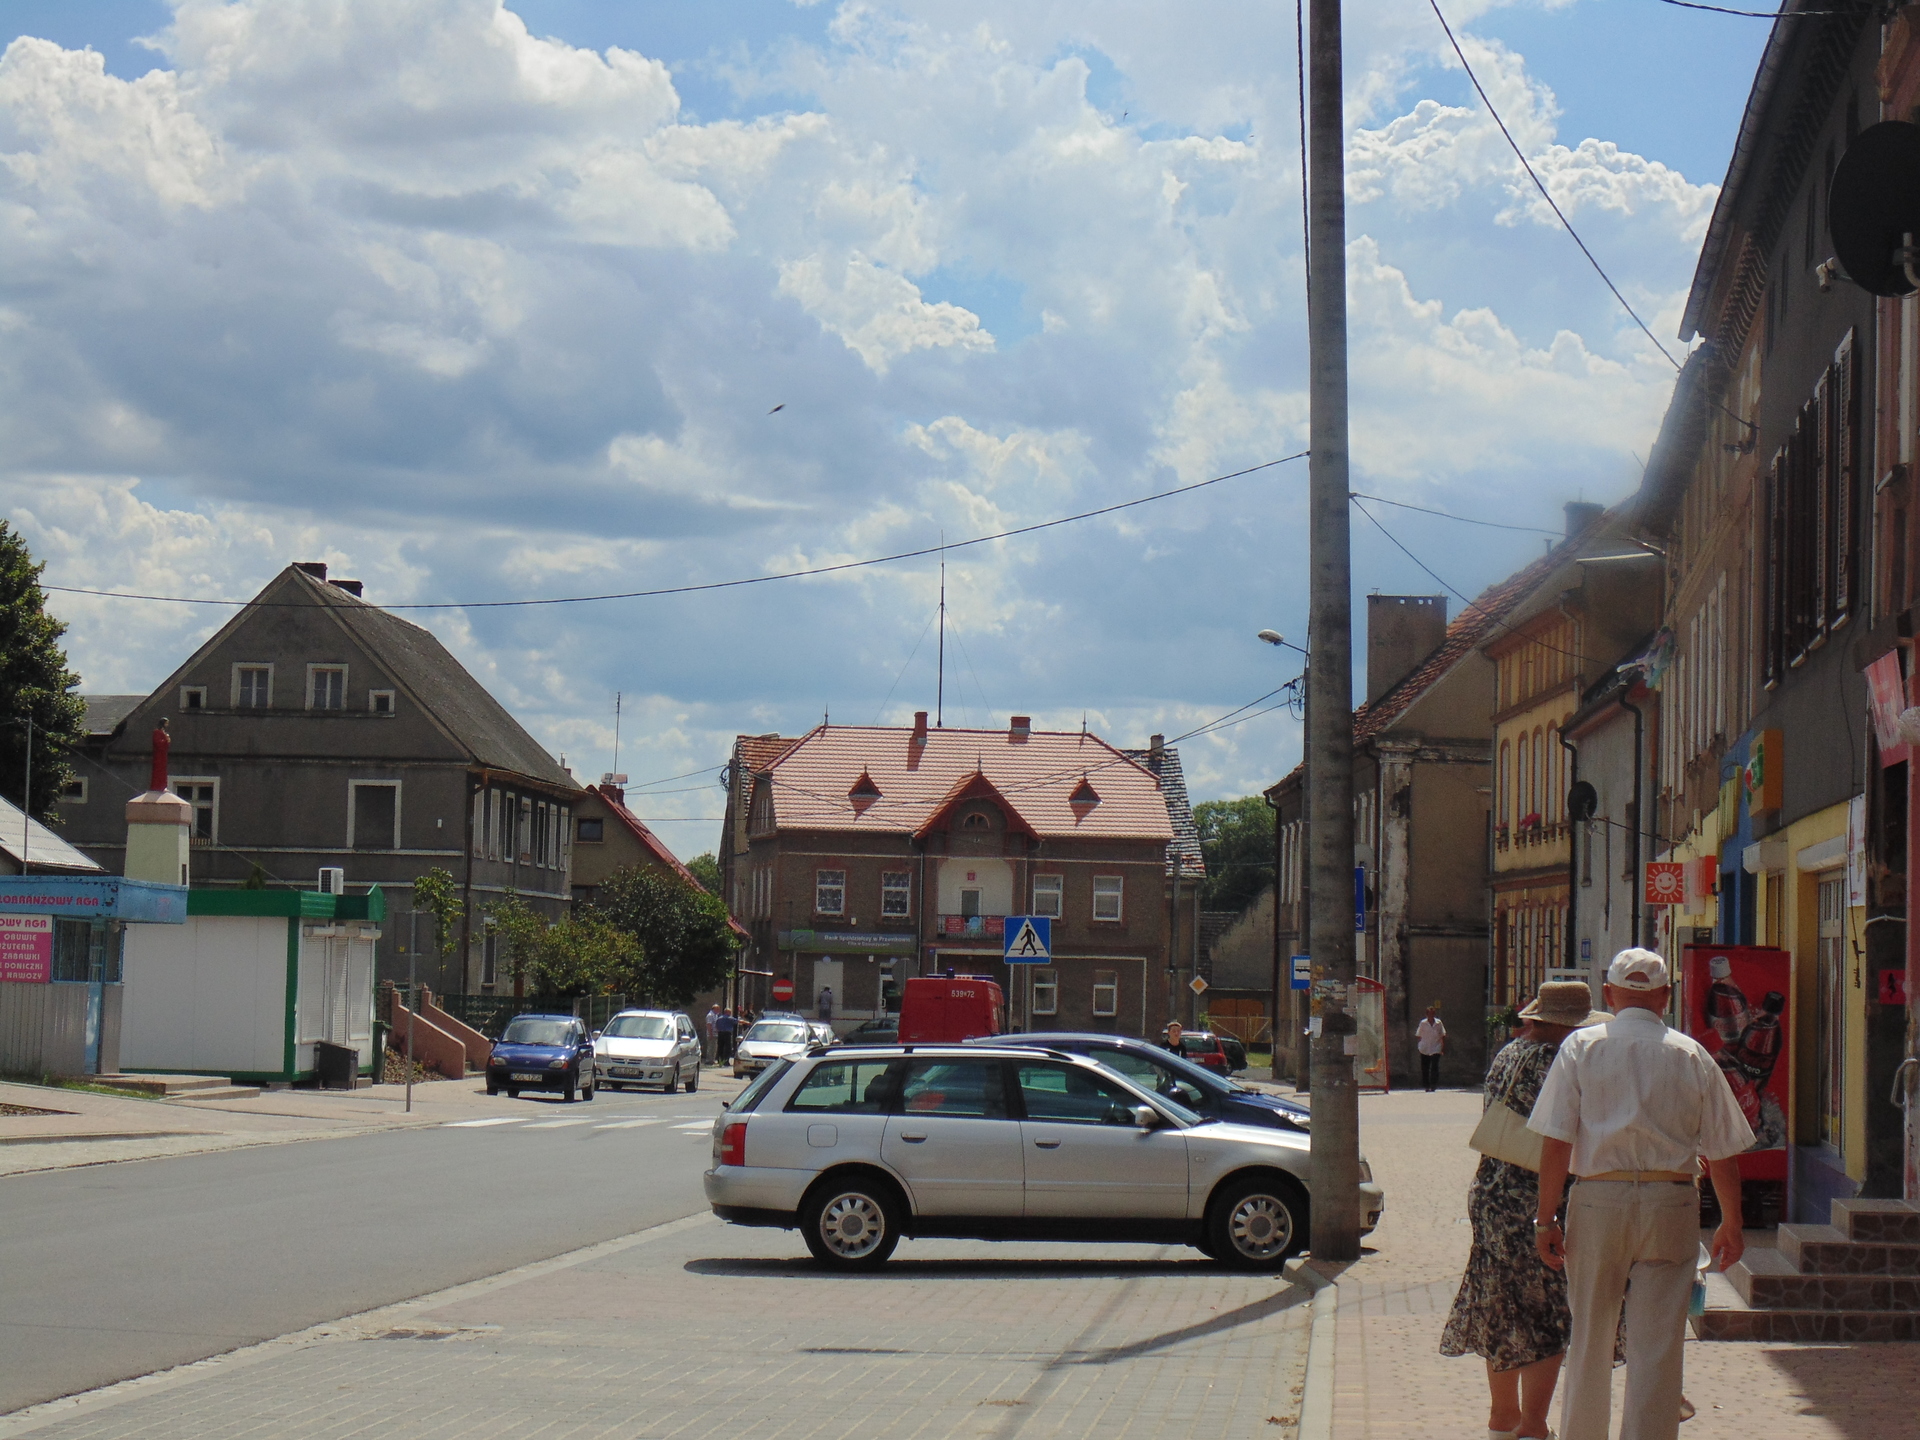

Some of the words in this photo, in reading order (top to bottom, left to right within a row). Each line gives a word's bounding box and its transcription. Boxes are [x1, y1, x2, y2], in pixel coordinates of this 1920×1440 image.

[76, 897, 99, 906] AGA
[25, 919, 47, 928] AGA
[4, 933, 37, 941] OBUWIE
[3, 952, 40, 960] ZABAWKI
[4, 962, 43, 970] DONICZKI
